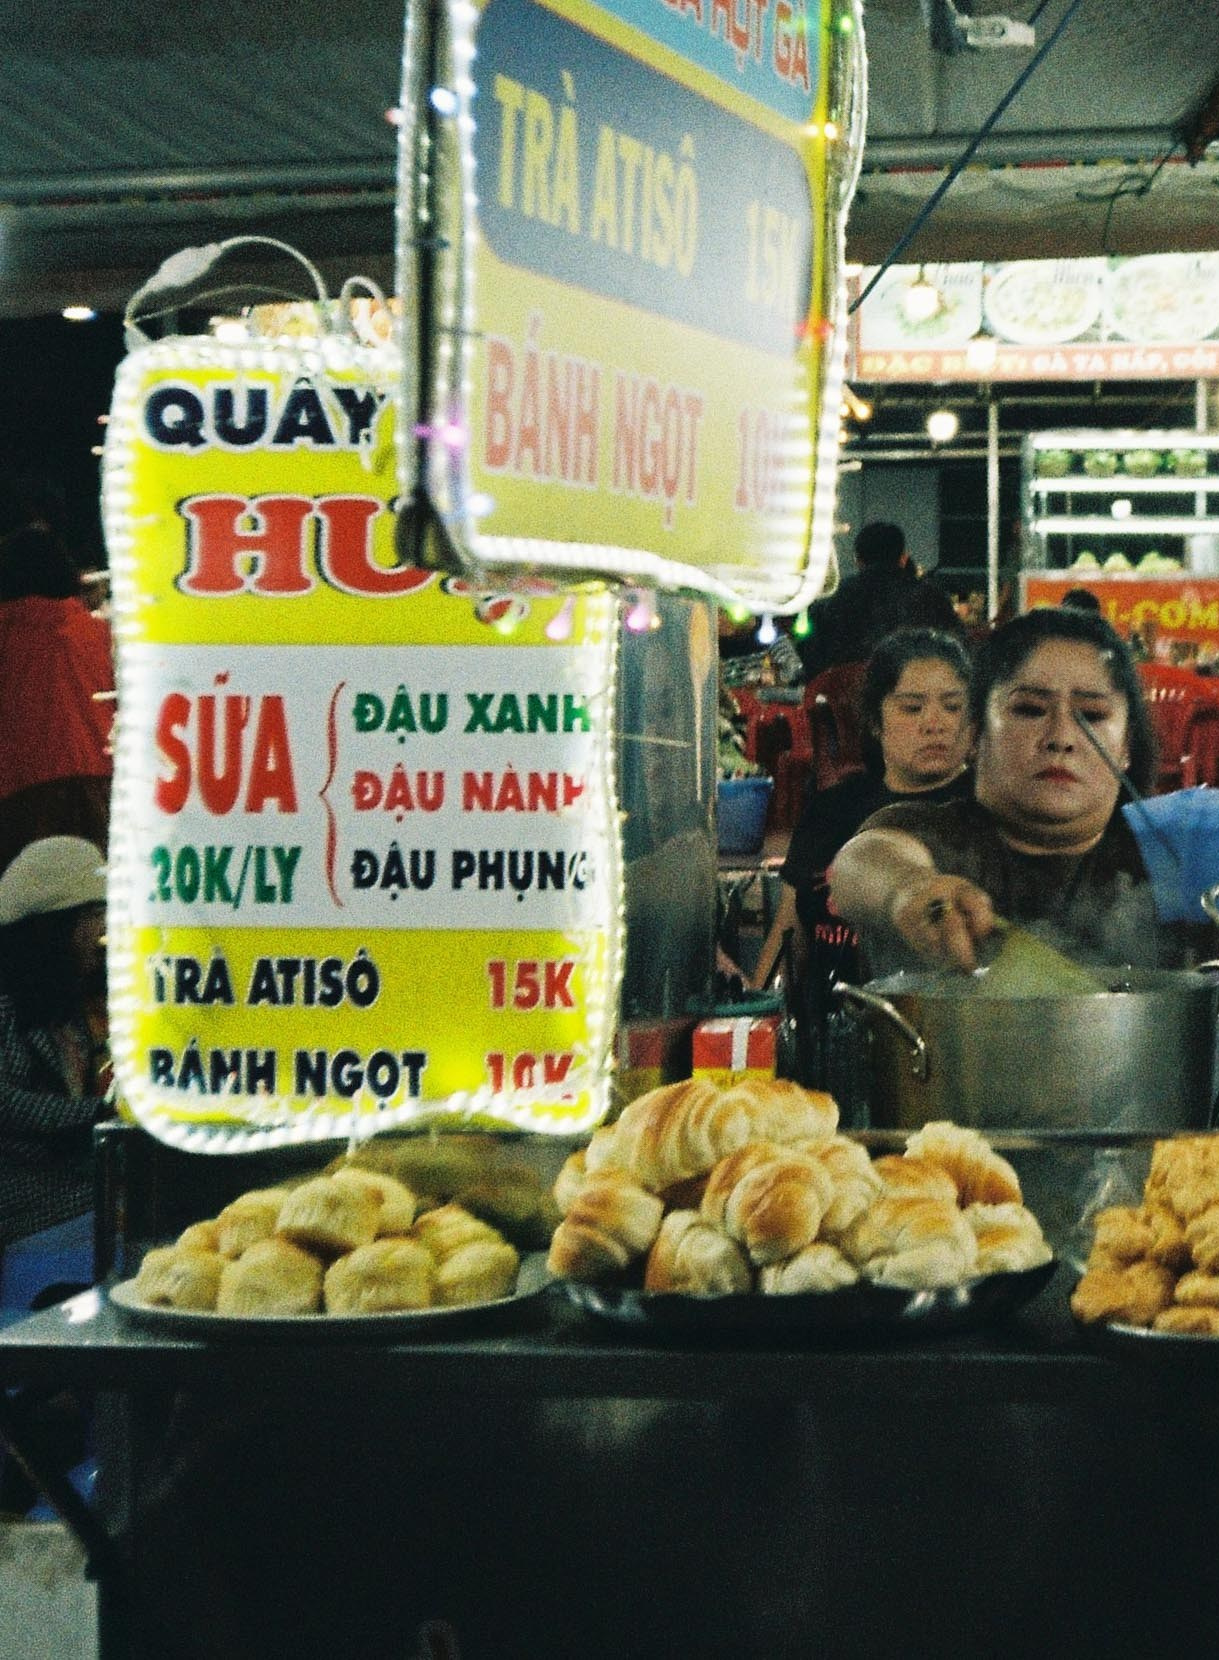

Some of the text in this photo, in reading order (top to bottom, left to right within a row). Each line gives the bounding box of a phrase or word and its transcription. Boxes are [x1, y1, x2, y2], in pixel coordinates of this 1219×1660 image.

[494, 70, 582, 236] TRÀ
[589, 133, 699, 279] ATISÔ
[485, 312, 601, 487] BÁNH
[611, 372, 705, 530] NGỌT
[177, 495, 558, 623] HU
[154, 671, 592, 816] SỮA ĐẬU XANH
[350, 763, 445, 822] ĐẬU
[149, 844, 302, 908] 20K/LY
[350, 841, 436, 900] ĐẬU
[247, 947, 381, 1008] ATISÔ
[487, 960, 576, 1009] 15K
[295, 1049, 427, 1109] NGỌT
